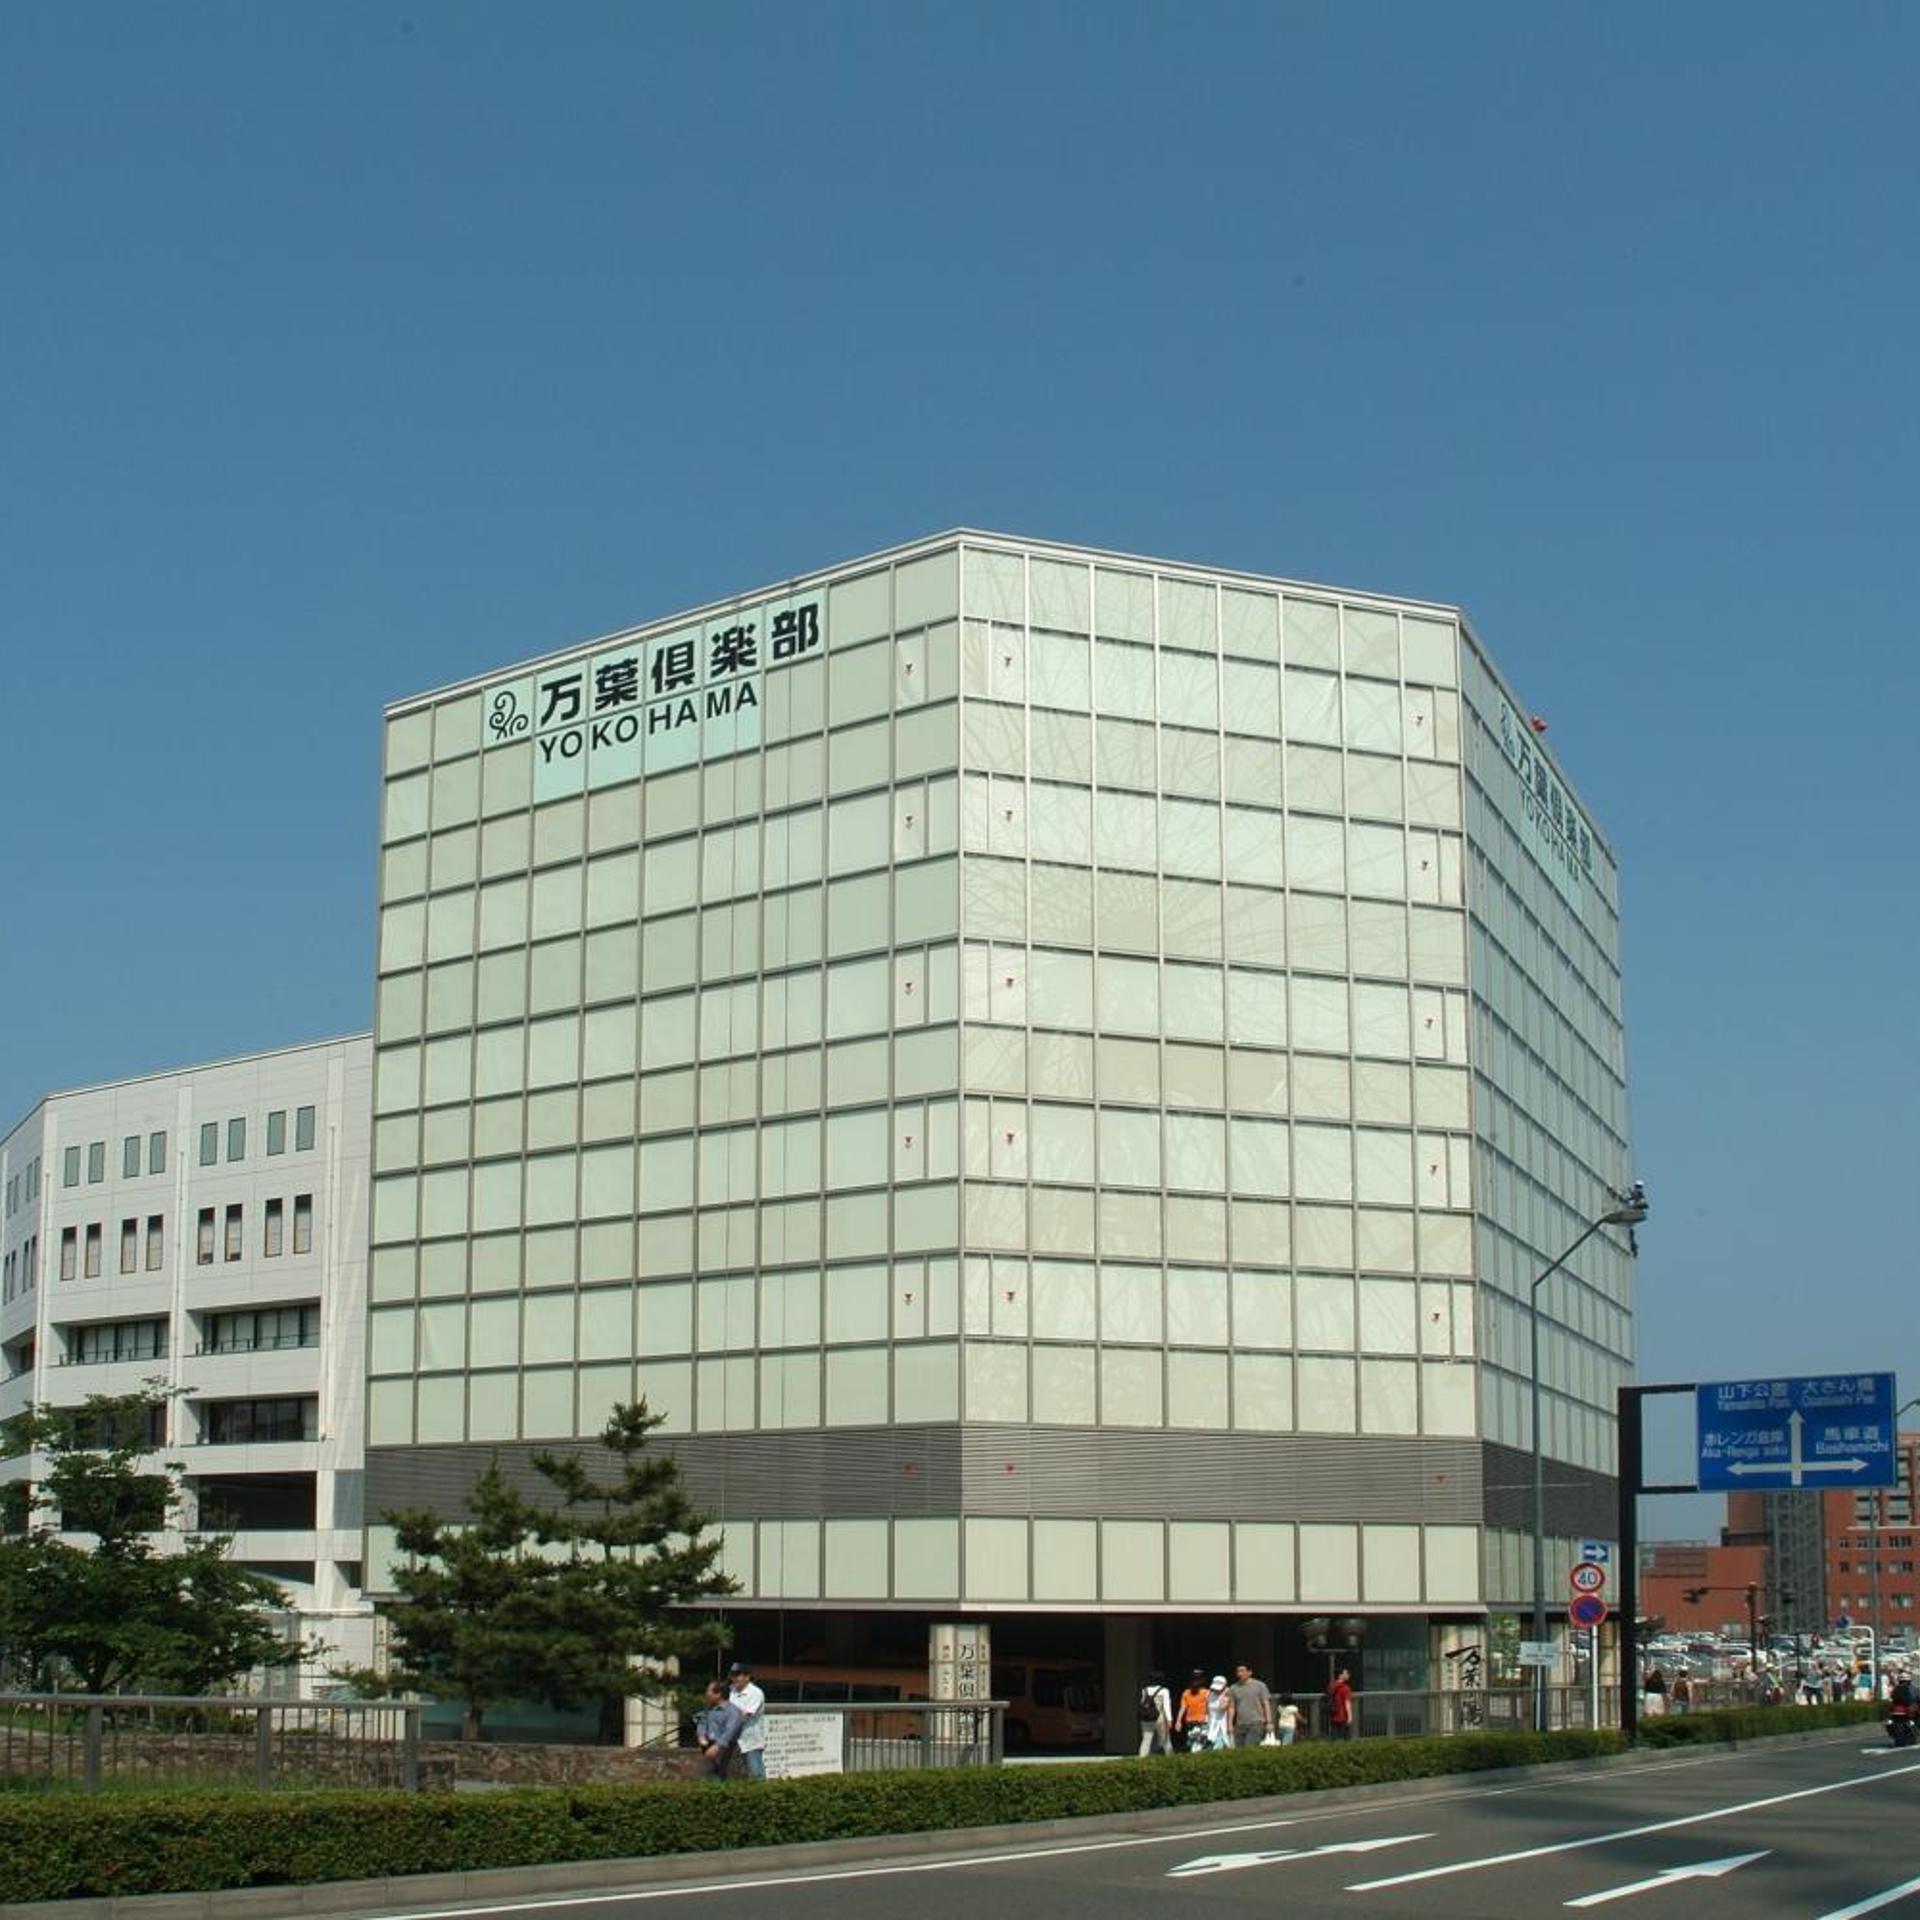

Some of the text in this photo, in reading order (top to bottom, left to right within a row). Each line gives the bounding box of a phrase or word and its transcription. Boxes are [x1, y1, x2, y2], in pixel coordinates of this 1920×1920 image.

[539, 603, 819, 727] 万葉倶楽部
[539, 682, 758, 763] YOKOHAMA
[1577, 1571, 1597, 1586] 40
